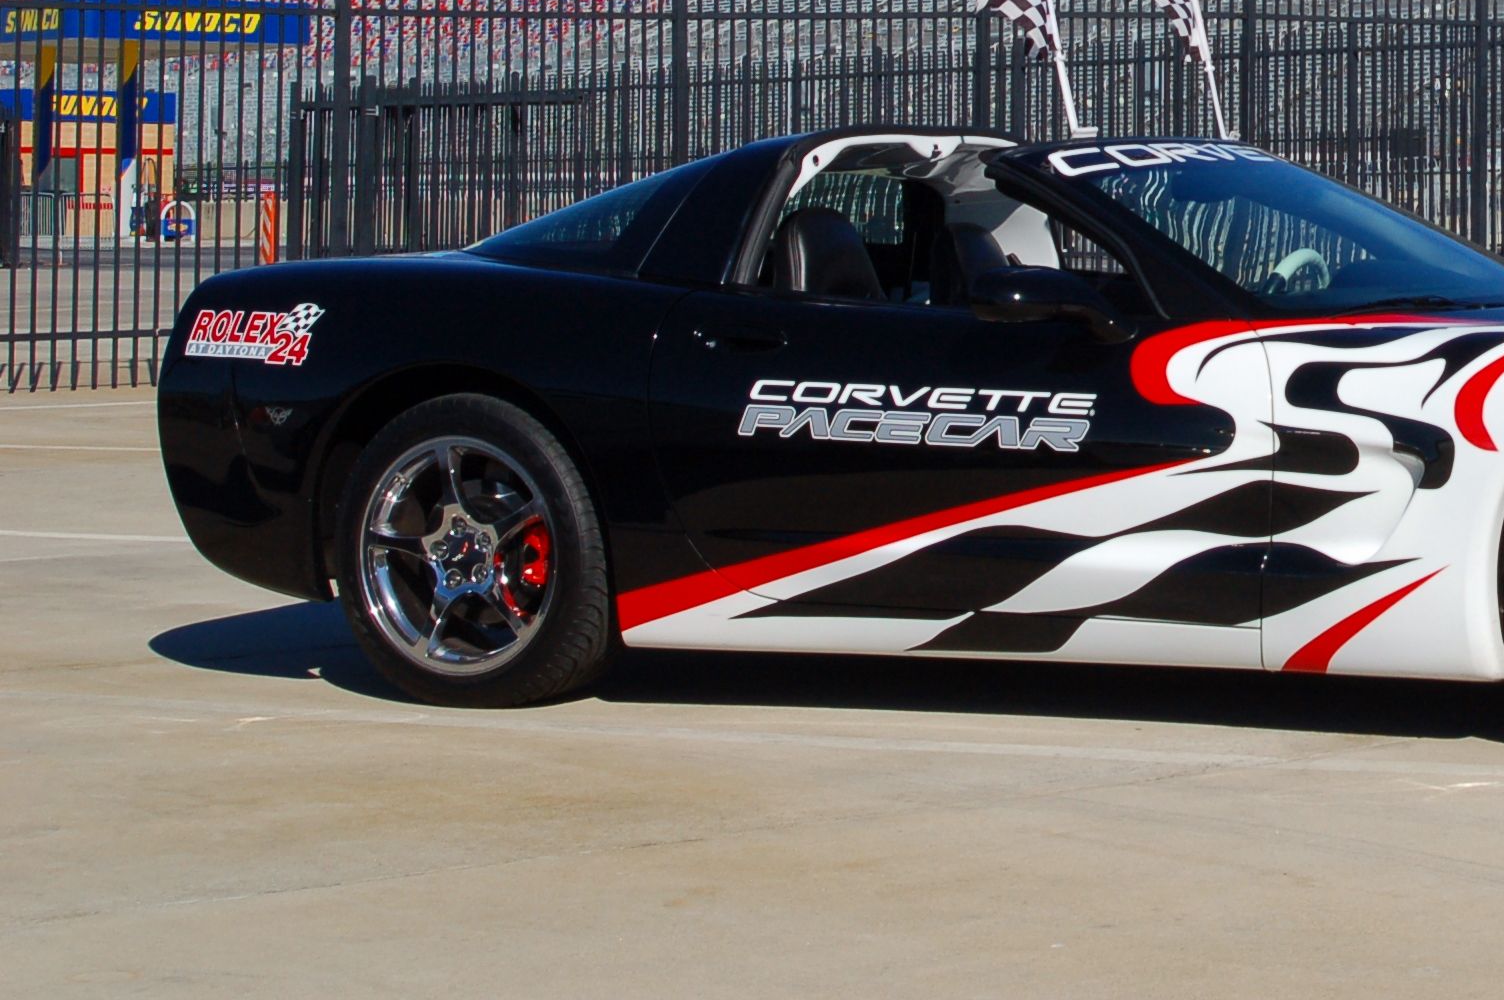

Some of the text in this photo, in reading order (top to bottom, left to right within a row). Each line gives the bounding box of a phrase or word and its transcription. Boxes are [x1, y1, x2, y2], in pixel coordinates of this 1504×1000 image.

[189, 309, 289, 346] ROLEX
[189, 344, 267, 357] AT DAYTONA
[265, 330, 312, 365] 24
[749, 379, 1098, 416] CORVETTE
